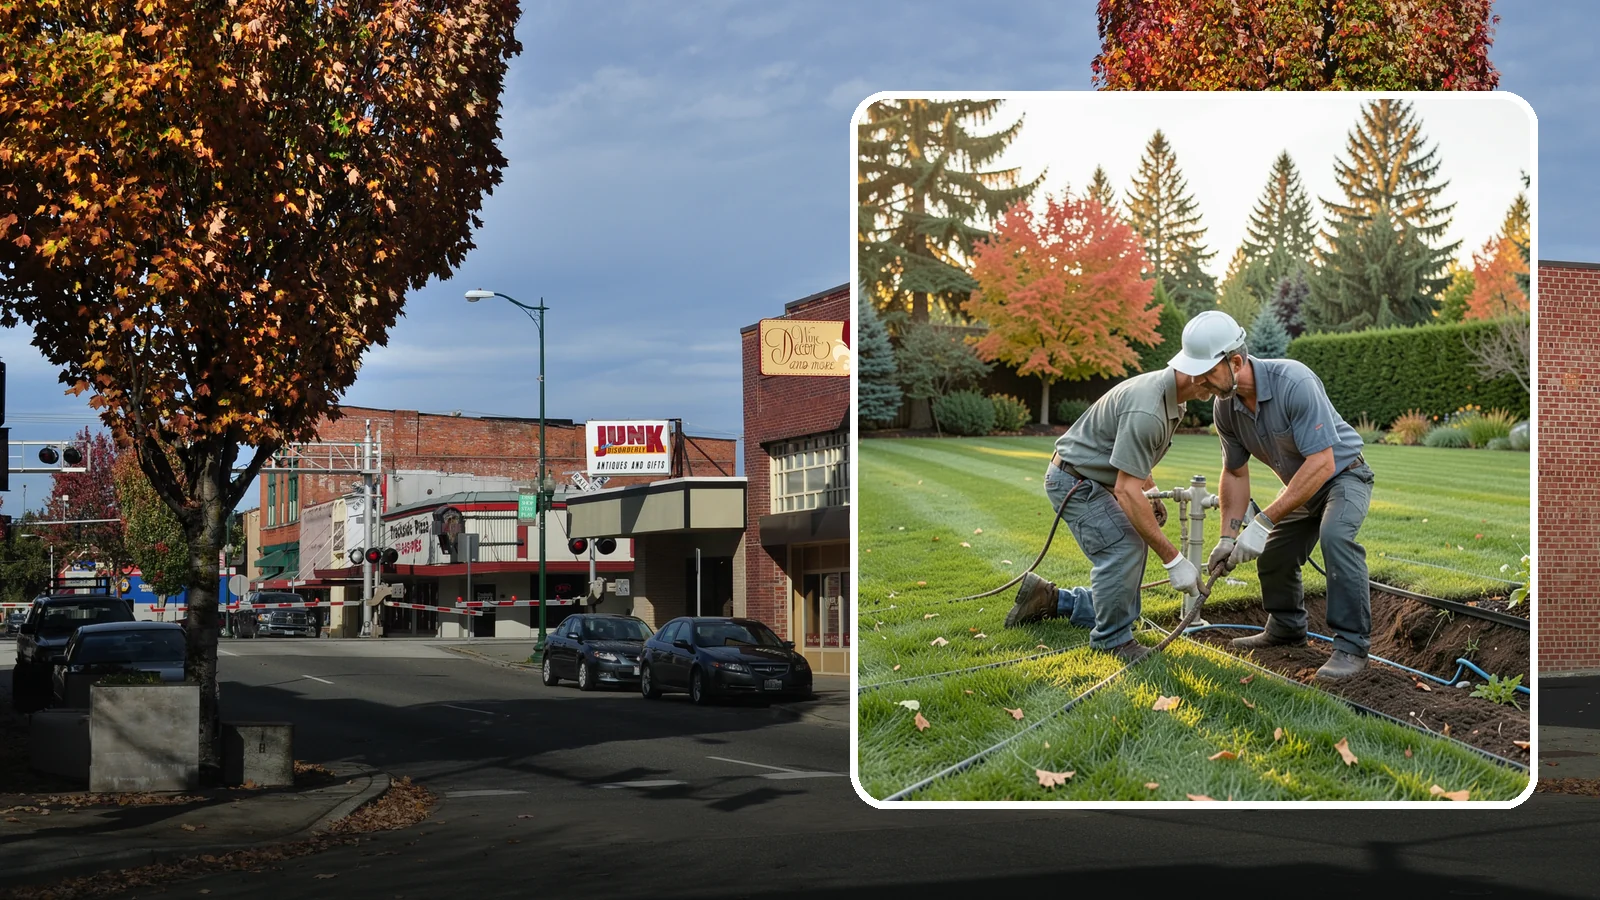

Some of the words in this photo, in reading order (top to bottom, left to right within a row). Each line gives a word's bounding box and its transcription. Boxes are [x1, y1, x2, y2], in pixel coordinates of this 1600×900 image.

[764, 327, 831, 365] Decor
[595, 425, 666, 457] JUNK
[607, 446, 646, 454] DISORDERLY
[597, 461, 628, 470] ANTIQUES
[631, 461, 644, 469] AND
[647, 460, 665, 469] GIFTS
[414, 519, 429, 535] Pizza
